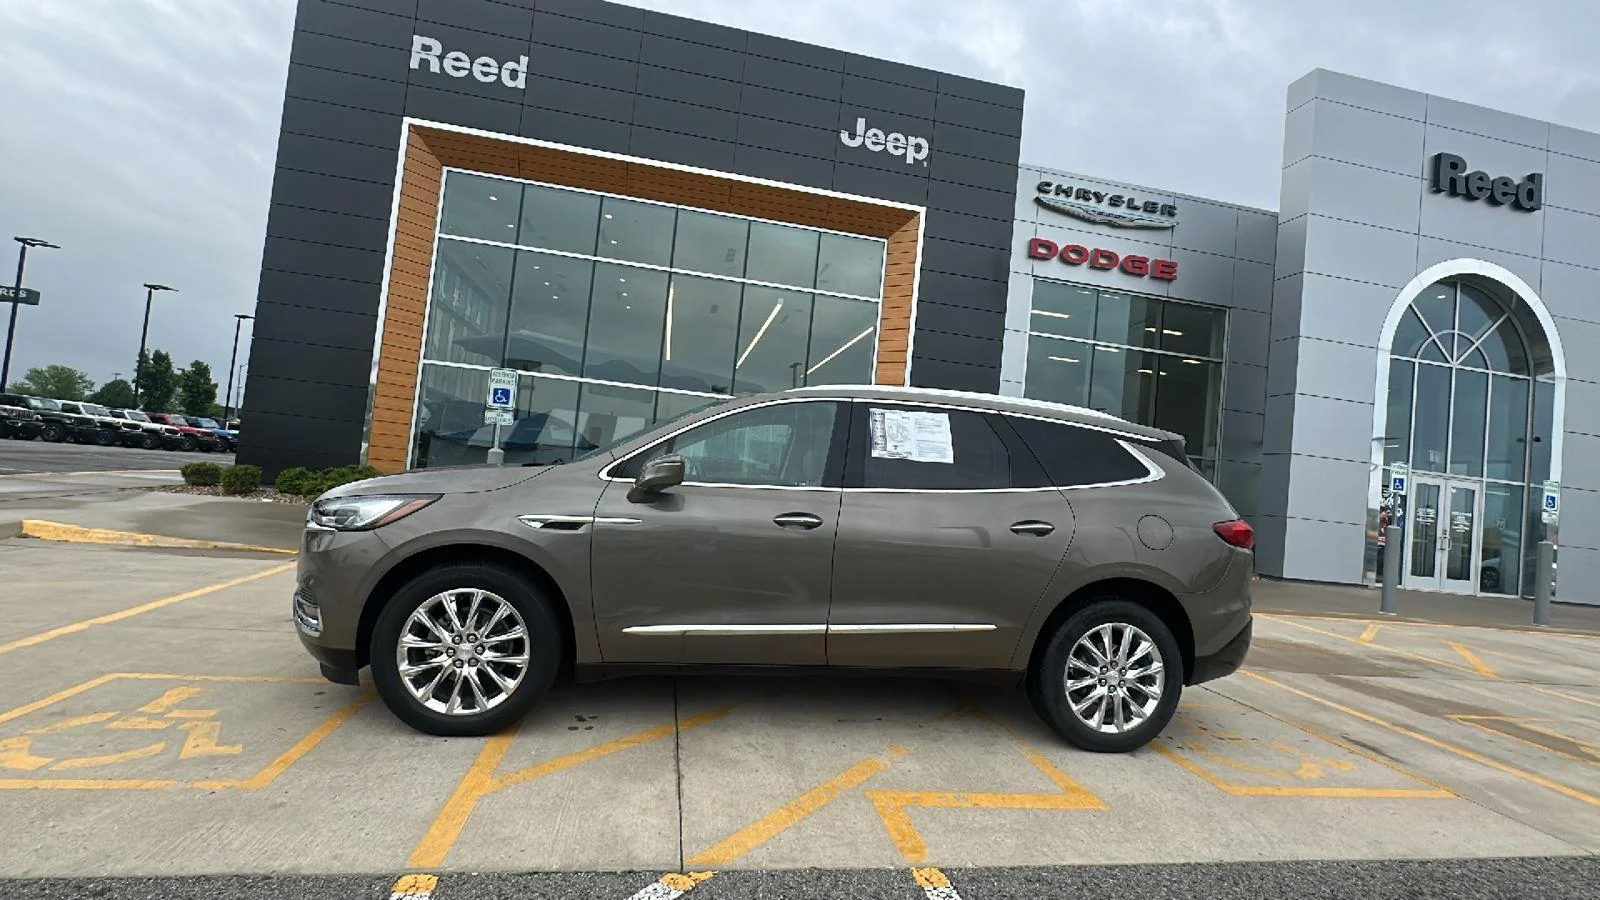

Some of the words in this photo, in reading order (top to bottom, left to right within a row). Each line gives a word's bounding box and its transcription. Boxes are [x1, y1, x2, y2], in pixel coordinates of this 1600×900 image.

[409, 34, 529, 90] Reed
[839, 116, 930, 164] Jeep
[1036, 180, 1178, 217] CHRYSLER
[1431, 151, 1544, 213] Reed
[1028, 238, 1179, 281] DODGE
